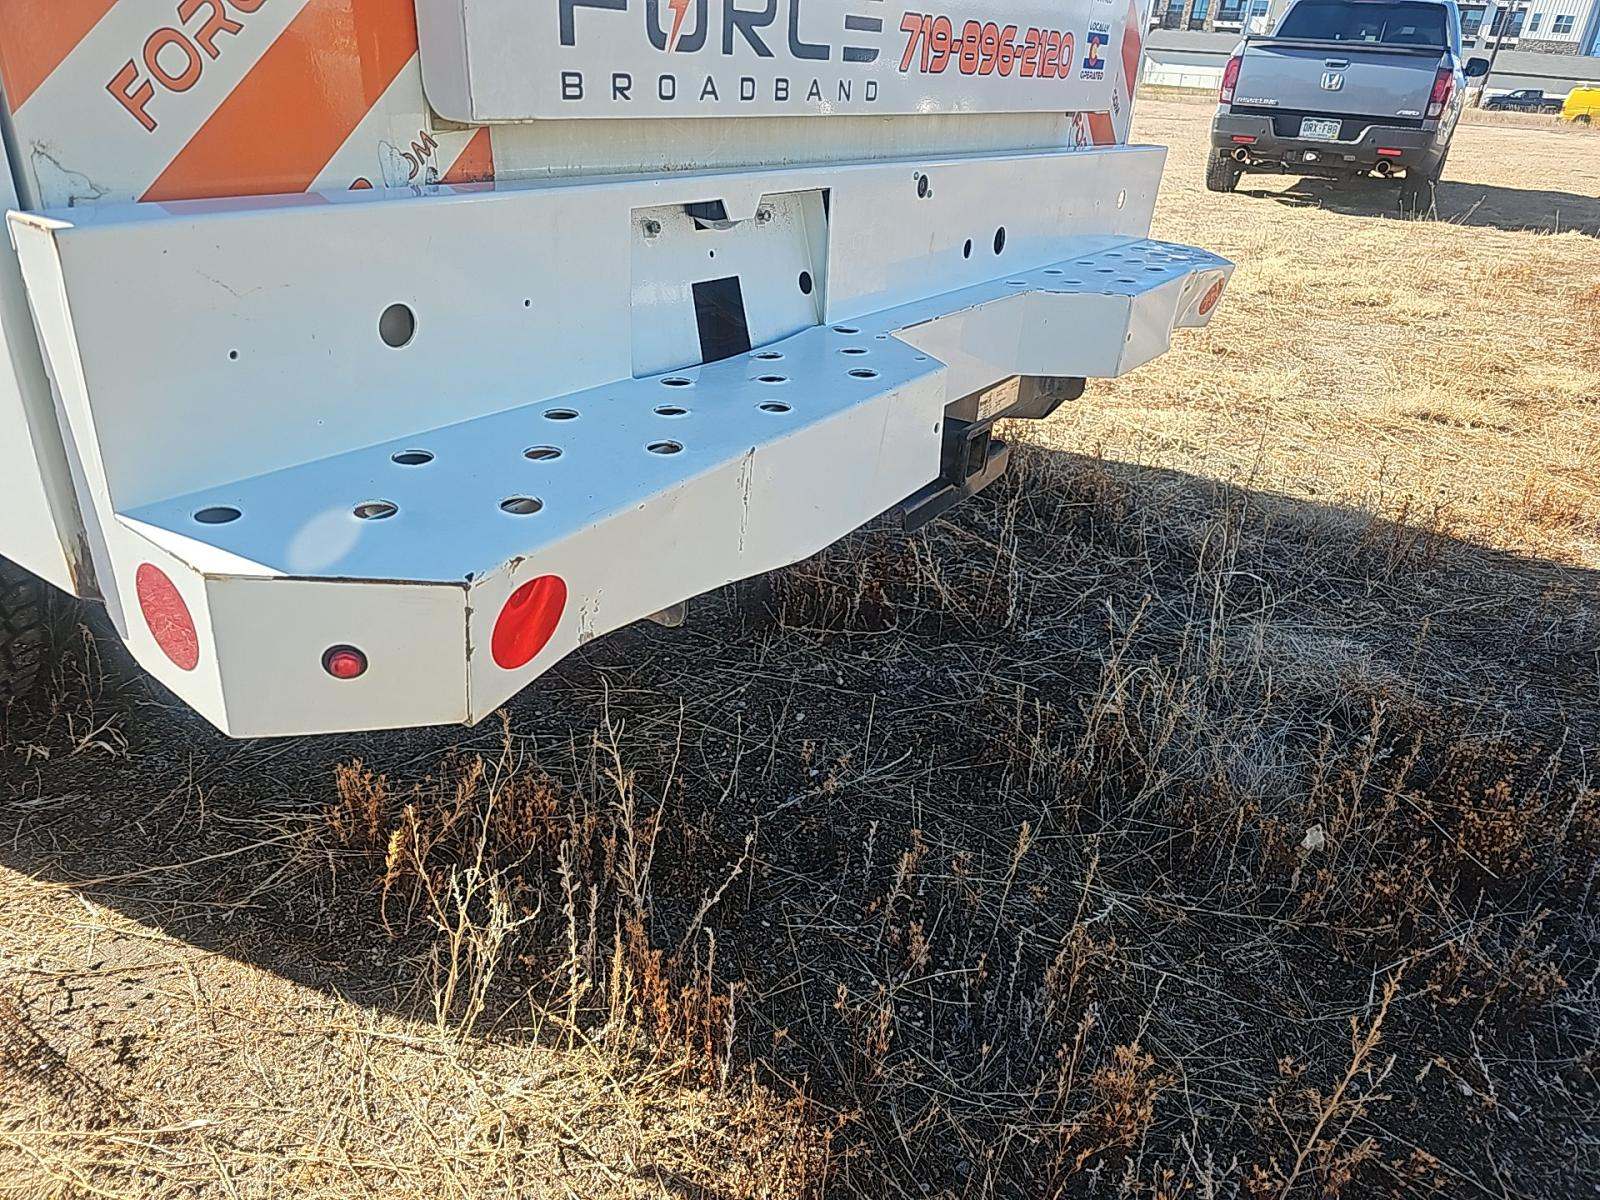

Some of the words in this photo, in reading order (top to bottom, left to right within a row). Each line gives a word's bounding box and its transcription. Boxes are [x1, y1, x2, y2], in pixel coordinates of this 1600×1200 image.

[559, 0, 882, 62] FORCE
[899, 12, 1074, 79] 719-896-2120
[105, 0, 267, 132] FOR
[561, 72, 878, 101] BROADBAND
